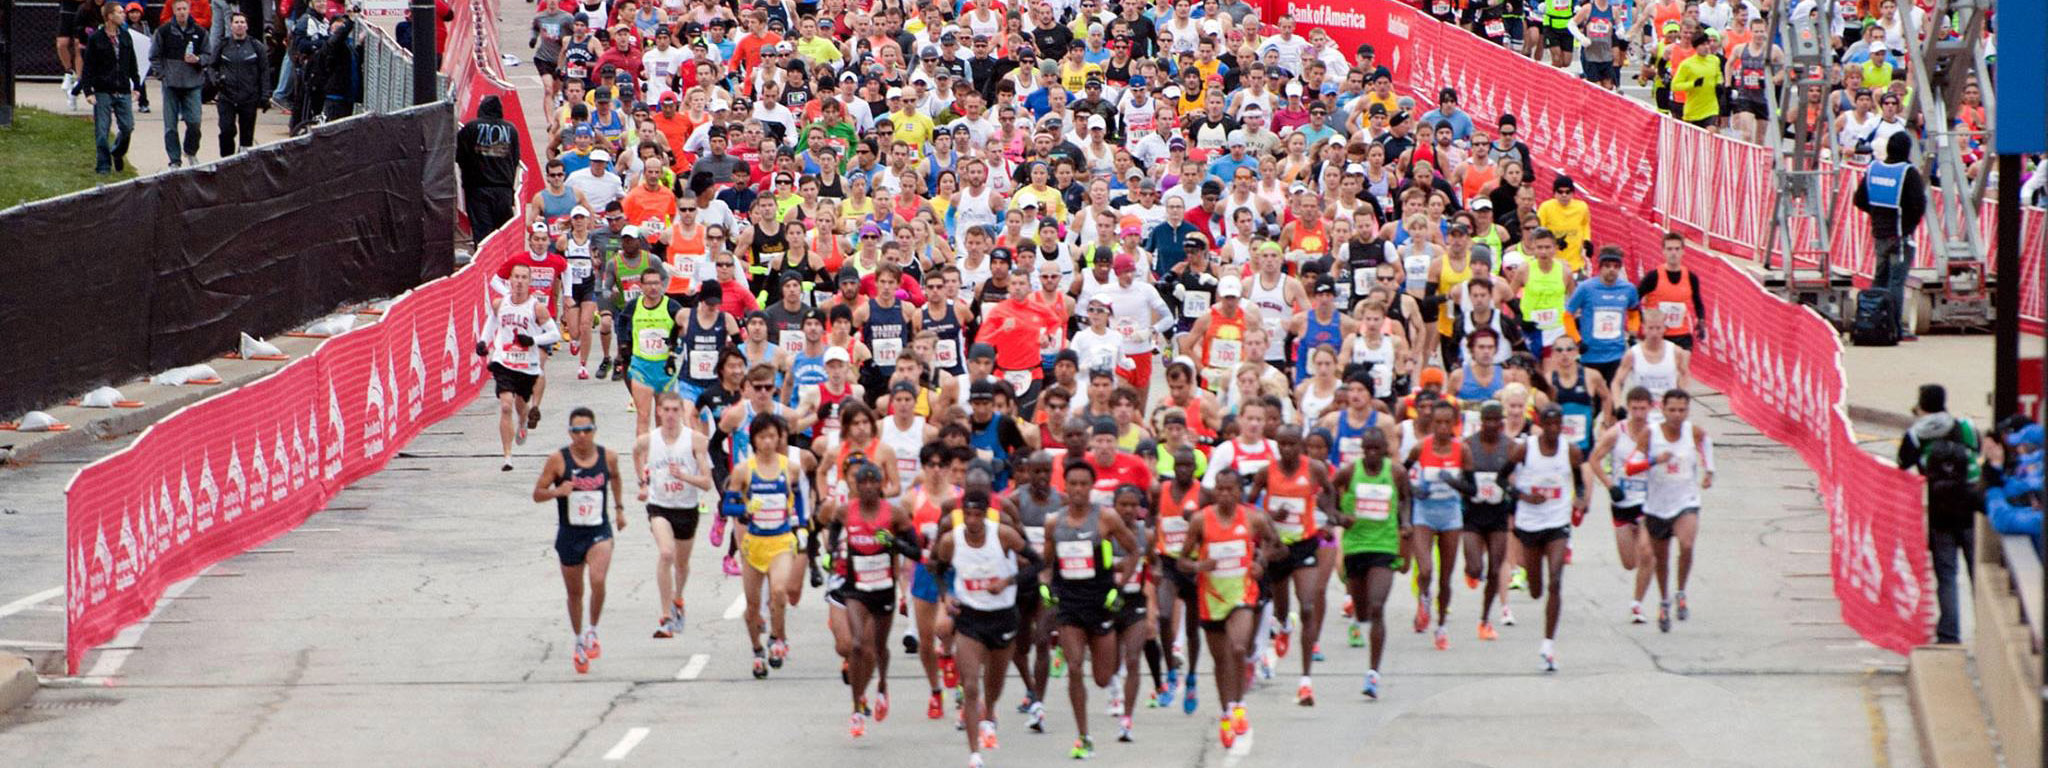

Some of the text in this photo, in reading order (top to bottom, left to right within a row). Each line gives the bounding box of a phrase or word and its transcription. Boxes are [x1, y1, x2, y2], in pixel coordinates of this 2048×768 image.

[1287, 2, 1313, 23] Bank
[1313, 5, 1325, 24] of
[1325, 6, 1365, 28] America
[477, 123, 511, 145] ZION
[502, 314, 528, 329] BULLS
[1217, 351, 1235, 361] 100
